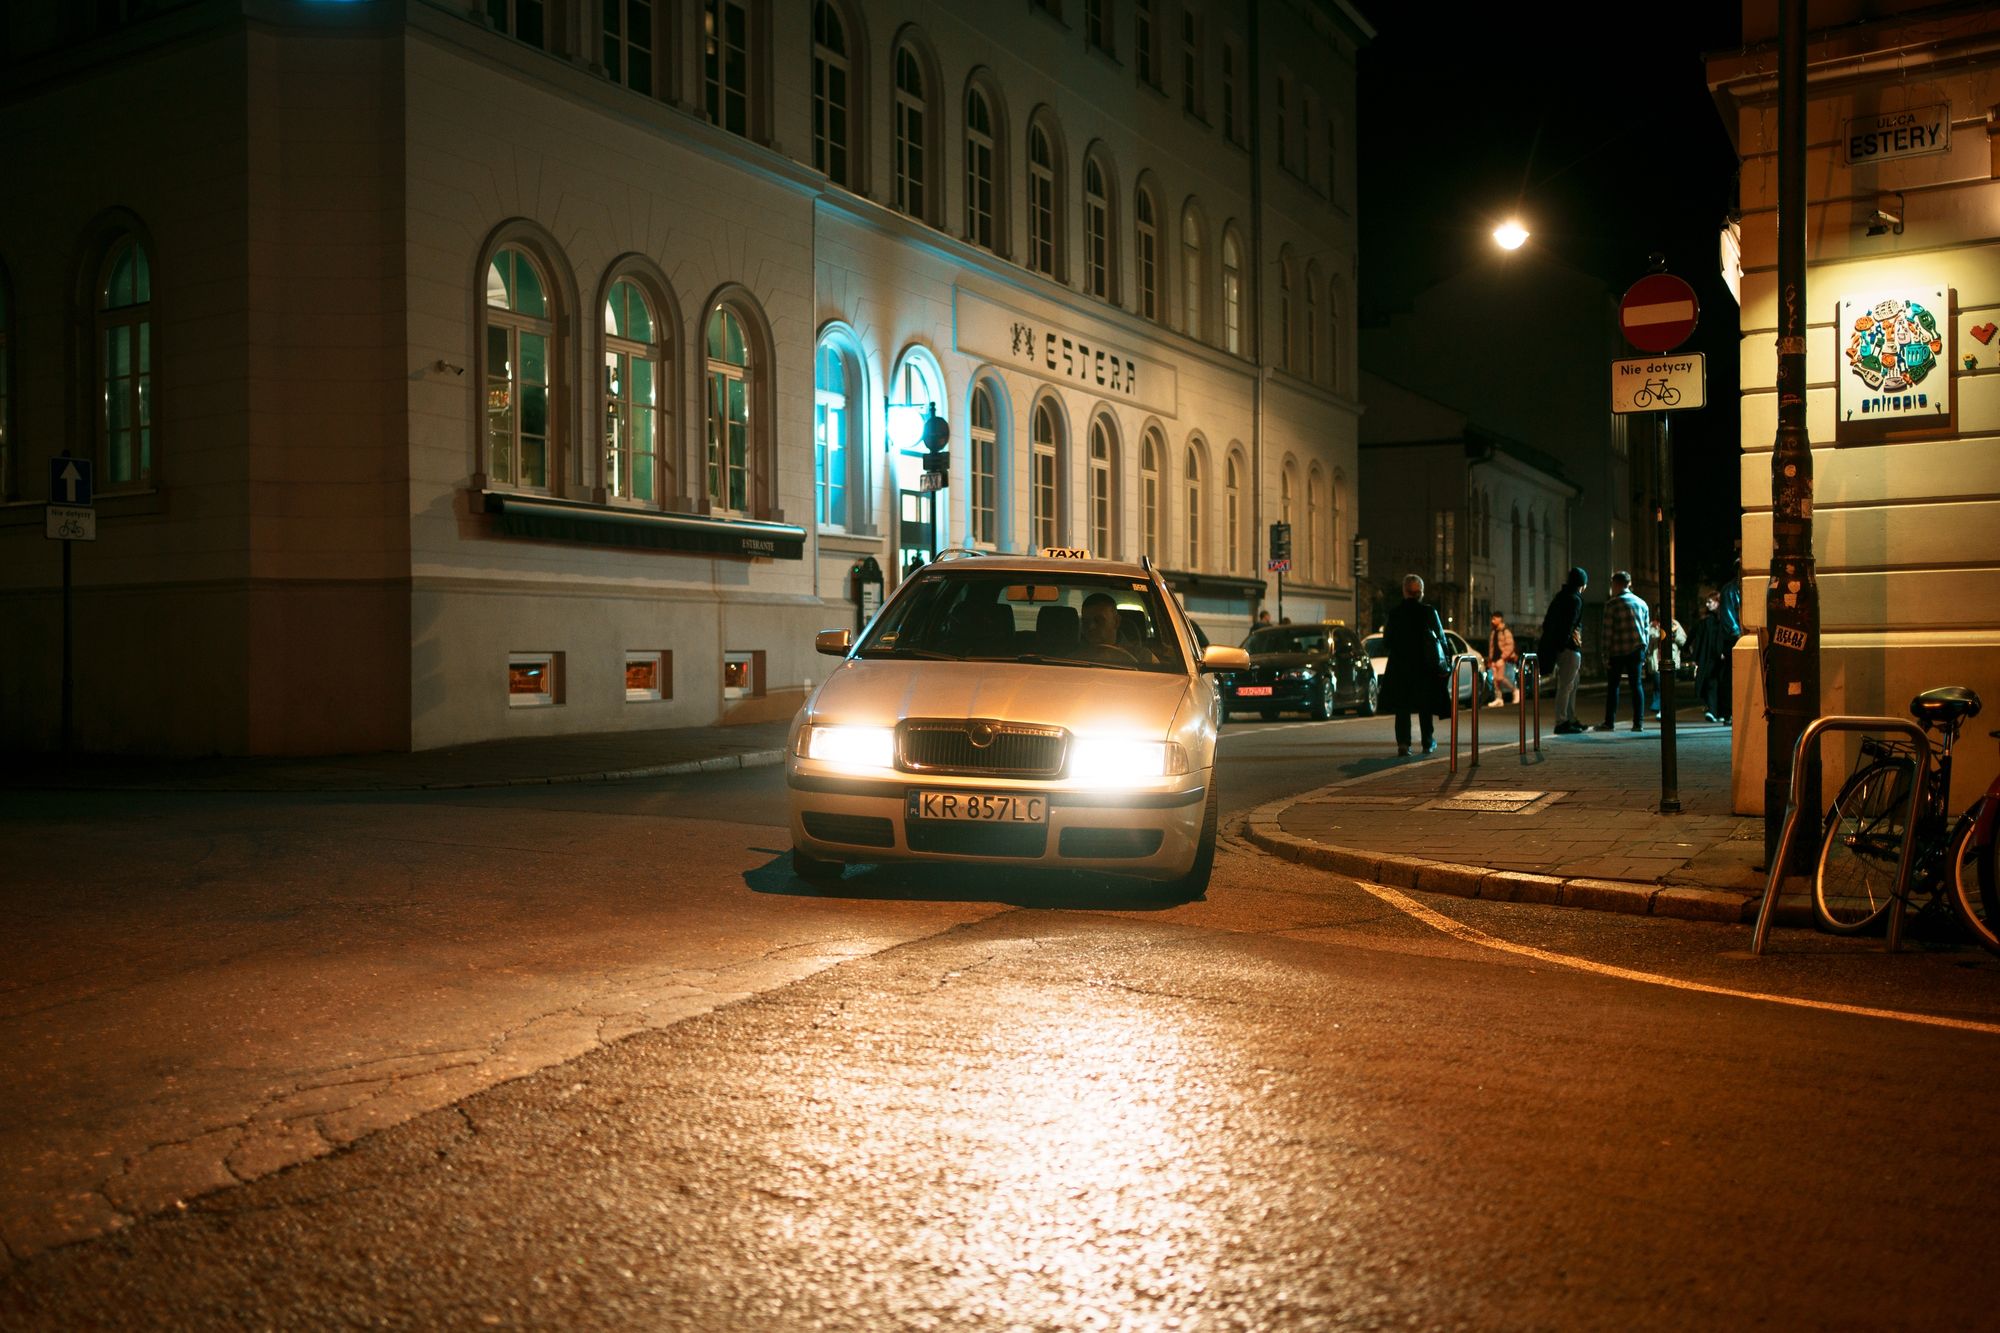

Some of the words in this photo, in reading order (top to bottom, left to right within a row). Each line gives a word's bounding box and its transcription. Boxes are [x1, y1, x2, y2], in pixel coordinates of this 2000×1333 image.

[1877, 113, 1916, 129] ULICA
[1850, 122, 1940, 158] ESTERY
[1046, 332, 1136, 396] ESTERA
[1620, 365, 1642, 376] Nie
[1646, 362, 1693, 373] dotyczy
[1862, 393, 1928, 413] entropia
[920, 473, 942, 492] TAXI
[1047, 549, 1085, 559] TAXI
[910, 807, 919, 815] PL
[924, 794, 957, 818] KR
[967, 796, 1041, 821] 857LC
